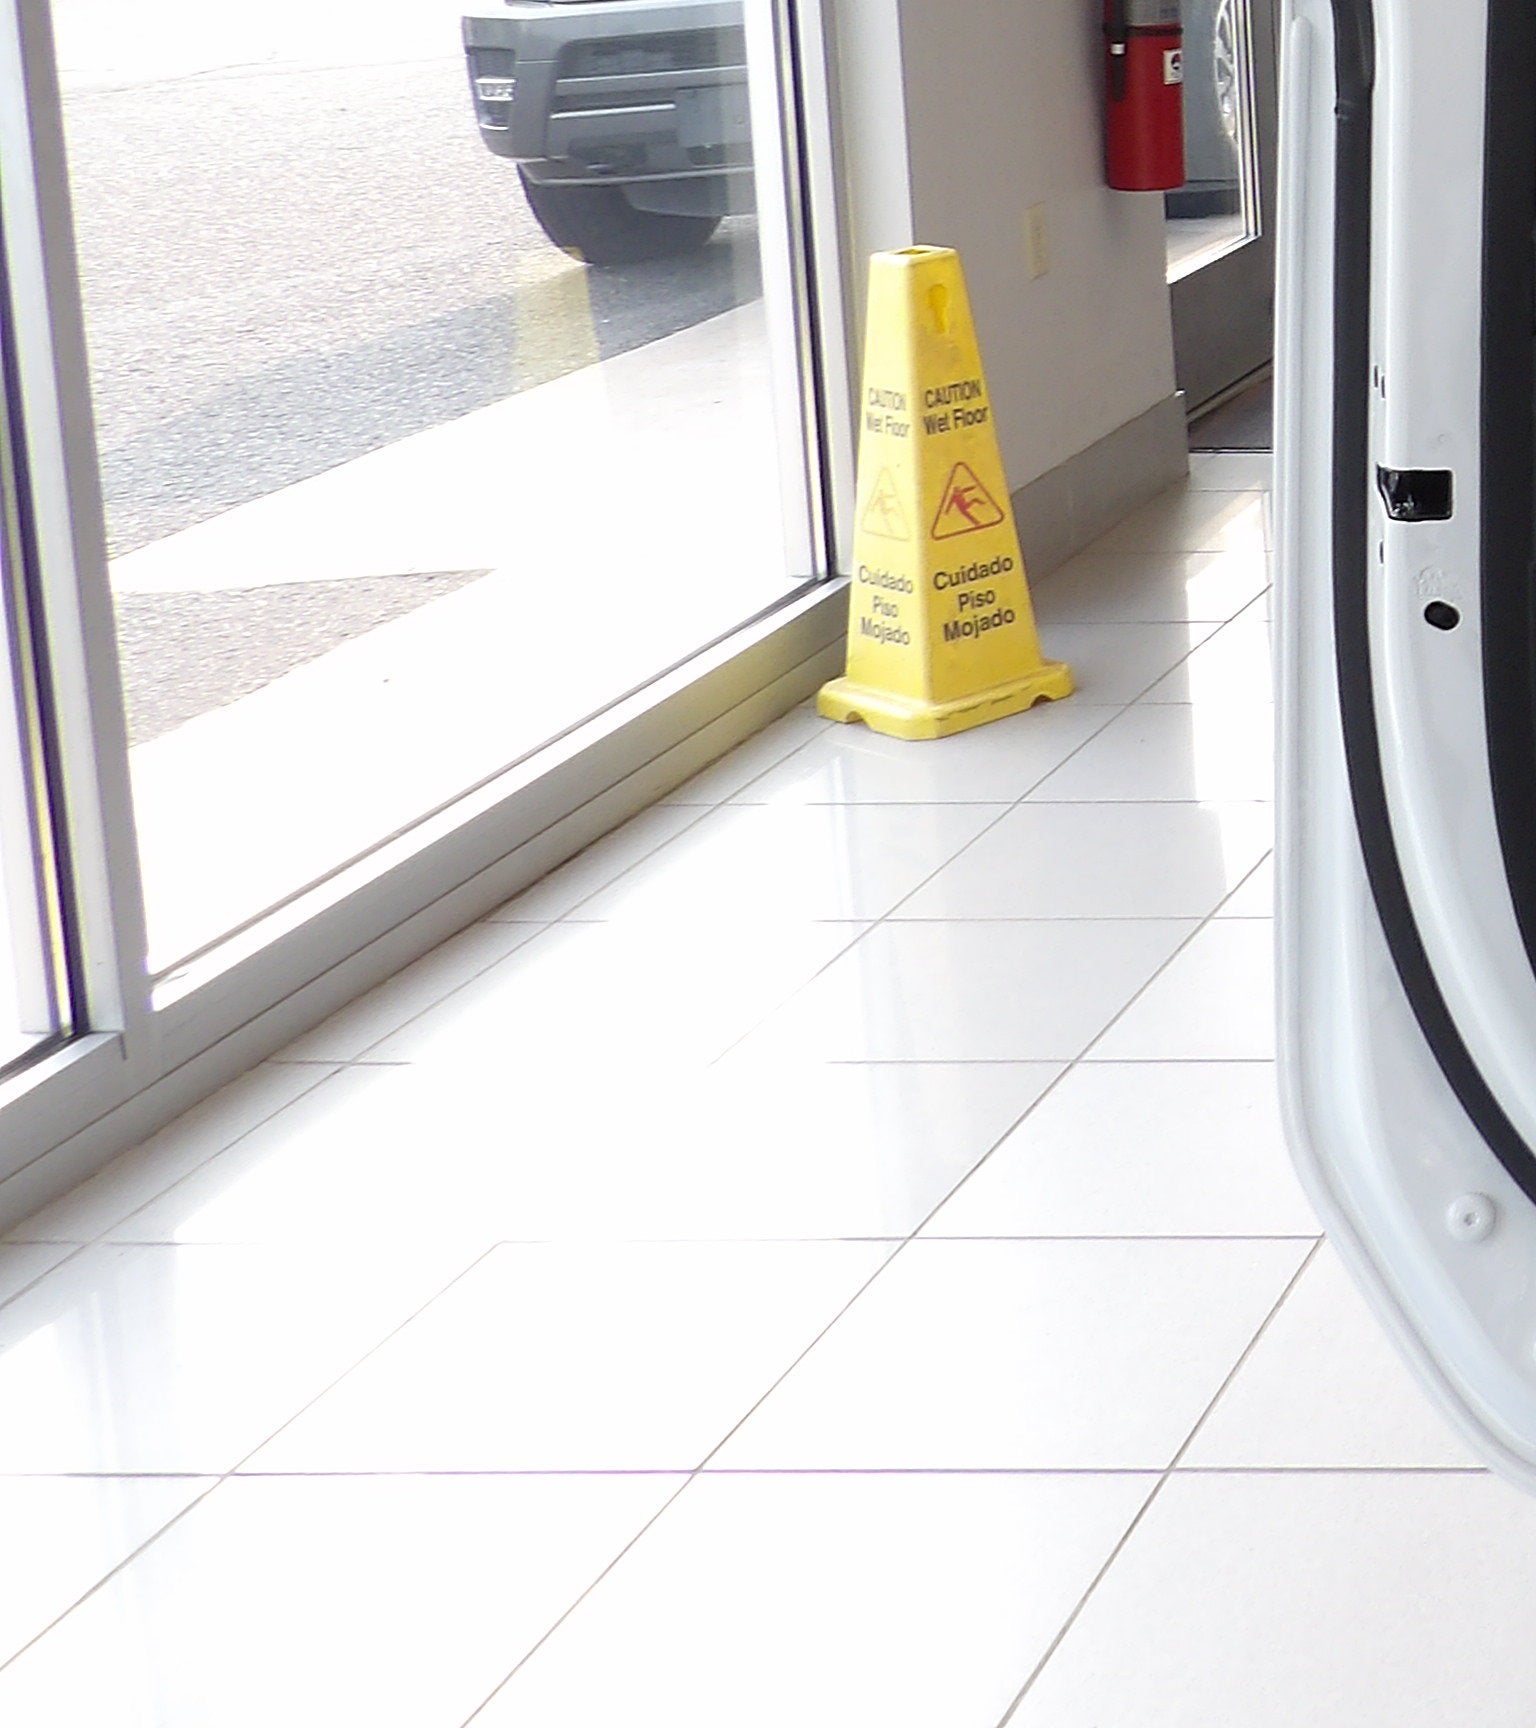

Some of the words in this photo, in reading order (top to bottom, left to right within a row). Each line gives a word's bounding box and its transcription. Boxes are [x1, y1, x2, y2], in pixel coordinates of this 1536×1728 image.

[868, 387, 906, 411] CAUTION
[925, 379, 981, 408] CAUTION
[865, 412, 883, 433] Wet
[885, 415, 910, 437] Floor
[923, 412, 951, 435] Wet
[953, 407, 988, 430] Floor
[859, 565, 914, 594] Cuidado
[933, 556, 1014, 590] Cuidado
[872, 595, 898, 618] Piso
[958, 590, 996, 612] Piso
[861, 617, 910, 645] Mojado
[944, 609, 1015, 641] Mojado
